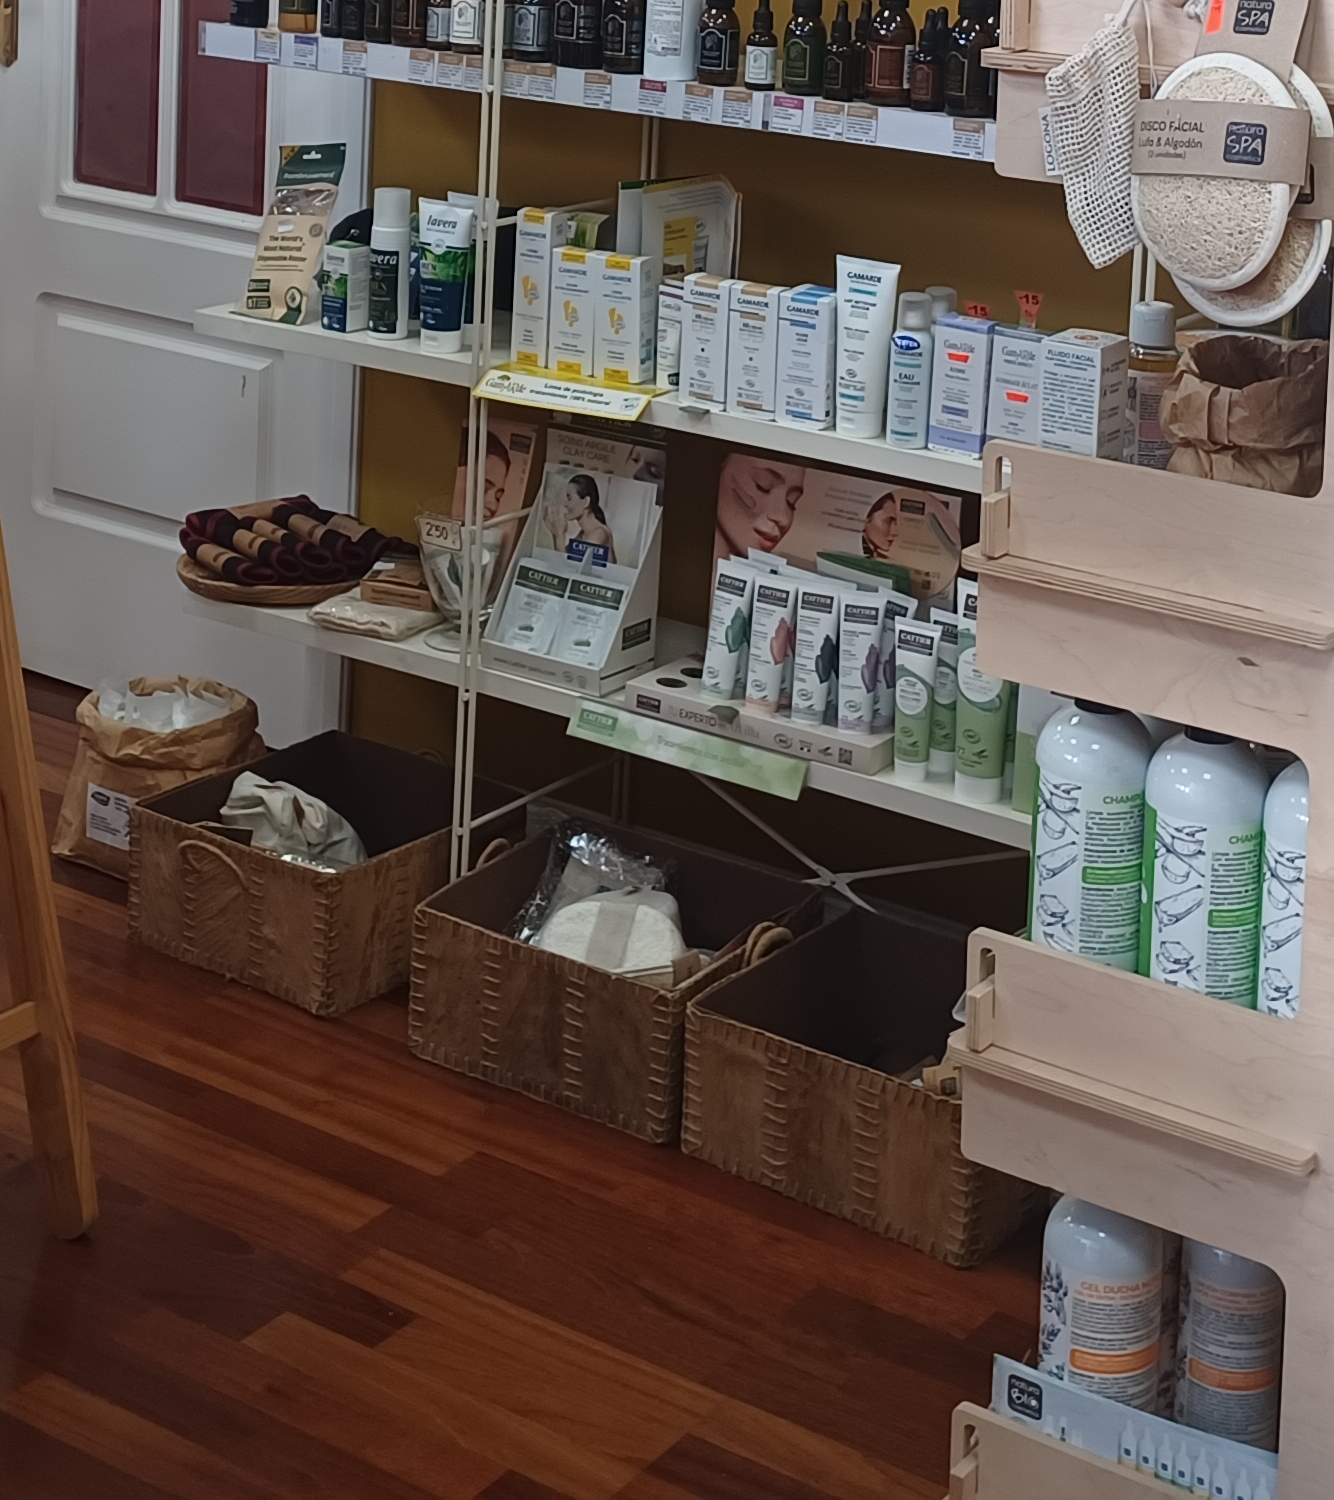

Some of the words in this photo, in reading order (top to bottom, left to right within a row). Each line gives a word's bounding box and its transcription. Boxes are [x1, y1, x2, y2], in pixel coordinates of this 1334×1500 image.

[1239, 0, 1273, 10] natura
[1237, 10, 1270, 27] SPA
[1140, 120, 1167, 132] DISCO
[1168, 120, 1205, 133] FACIAL
[1041, 113, 1055, 172] LOGONA
[1138, 136, 1154, 148] Lufa
[1155, 137, 1162, 147] &
[1164, 137, 1203, 151] Algodón
[1226, 136, 1263, 155] SPA
[426, 213, 458, 230] lavera
[846, 271, 882, 285] GAMARDE
[690, 288, 721, 301] GAMARDE
[1018, 293, 1040, 306] -15
[737, 297, 770, 309] GAMARDE
[786, 304, 820, 317] GAMARDE
[968, 305, 988, 317] -15
[1047, 348, 1070, 359] FLUIDO
[1071, 353, 1096, 364] FACIAL
[898, 372, 915, 381] EAU
[528, 569, 559, 586] CATTIER
[719, 575, 746, 589] CATTIER
[579, 583, 614, 598] CATTIER
[758, 587, 788, 600] CATTIER
[803, 594, 832, 605] CATTIER
[847, 606, 877, 617] CATTIER
[900, 633, 932, 645] CATTIER
[582, 710, 615, 726] CATTIER
[679, 708, 717, 727] EXPERTO
